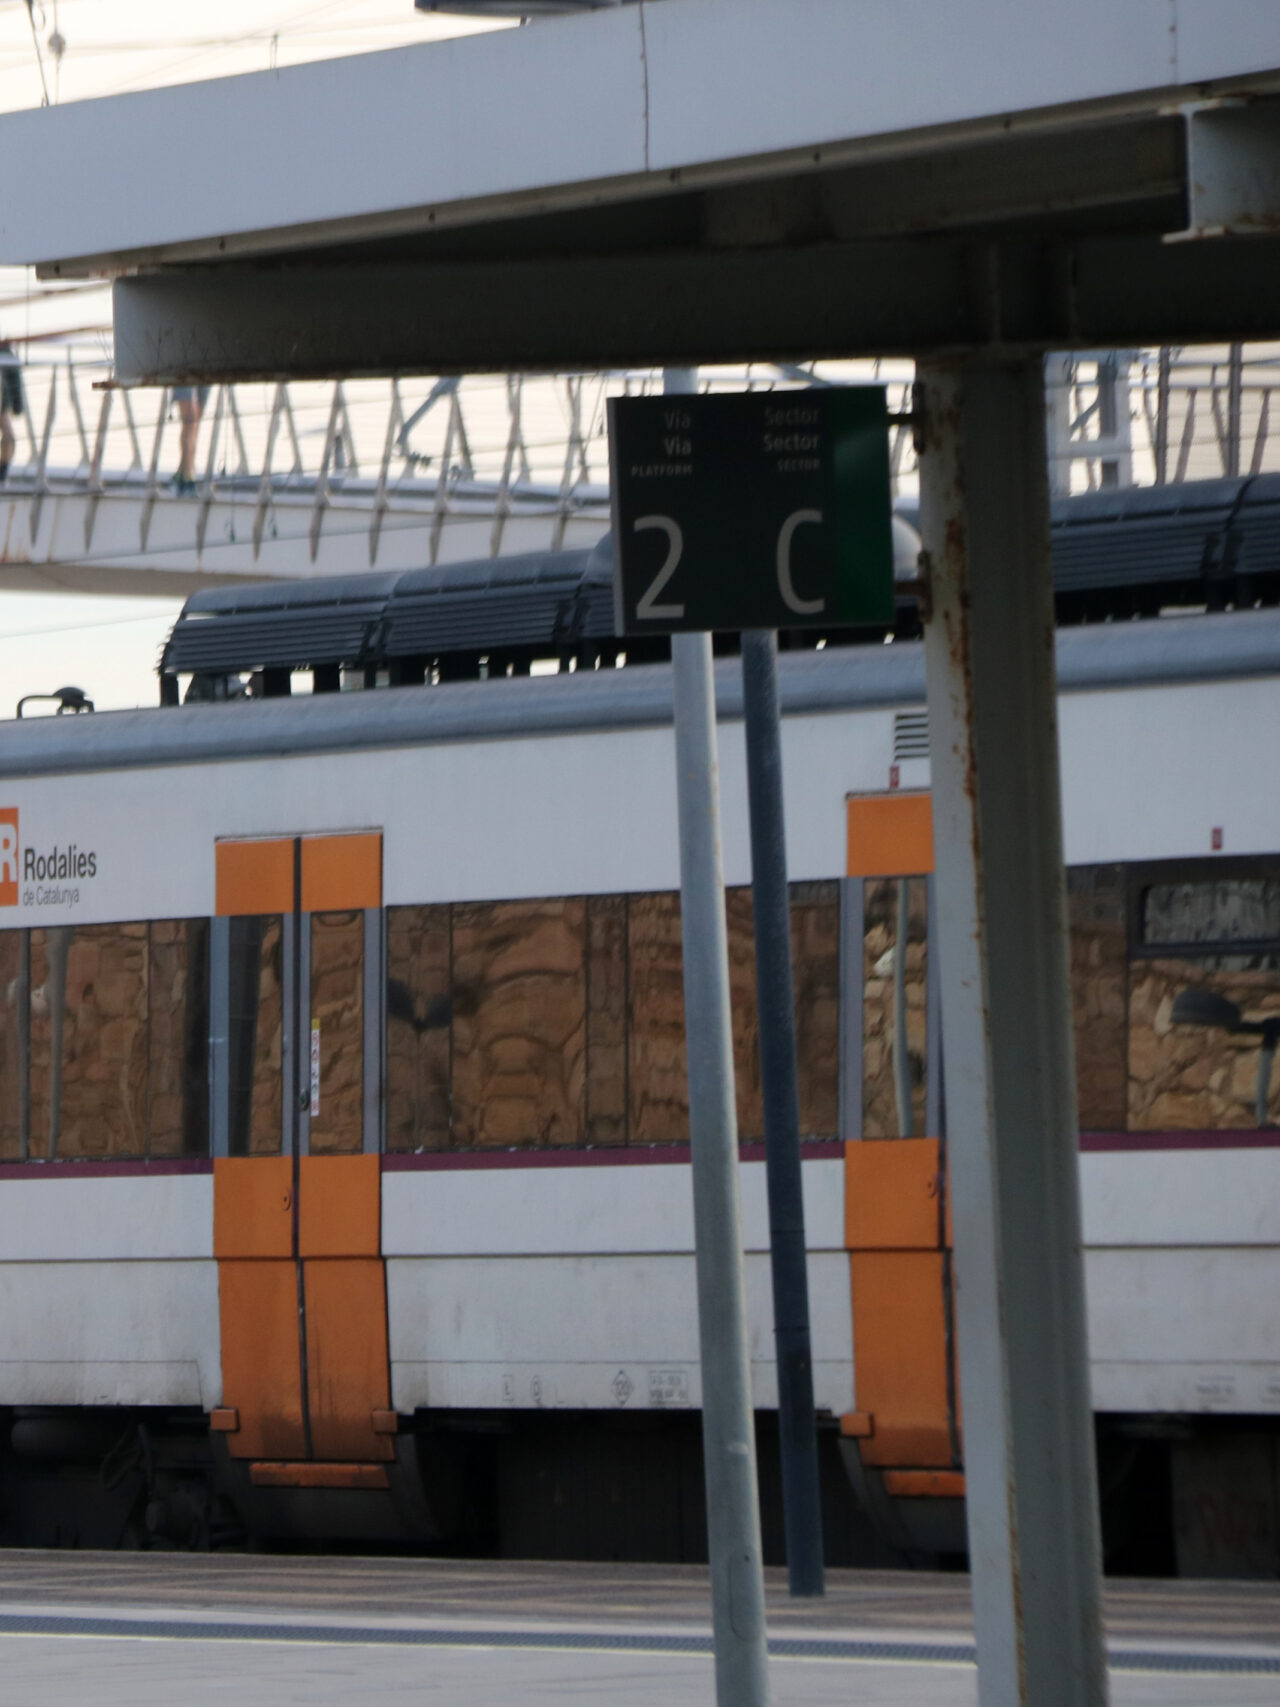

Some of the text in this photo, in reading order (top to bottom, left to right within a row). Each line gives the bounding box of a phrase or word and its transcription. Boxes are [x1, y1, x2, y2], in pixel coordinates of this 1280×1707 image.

[763, 406, 820, 426] Sector
[762, 432, 820, 453] Sector
[631, 464, 693, 477] PLATFORM
[633, 514, 686, 620] 2
[775, 509, 826, 615] C
[23, 844, 97, 881] Rodalies
[23, 885, 80, 909] de Catalunya
